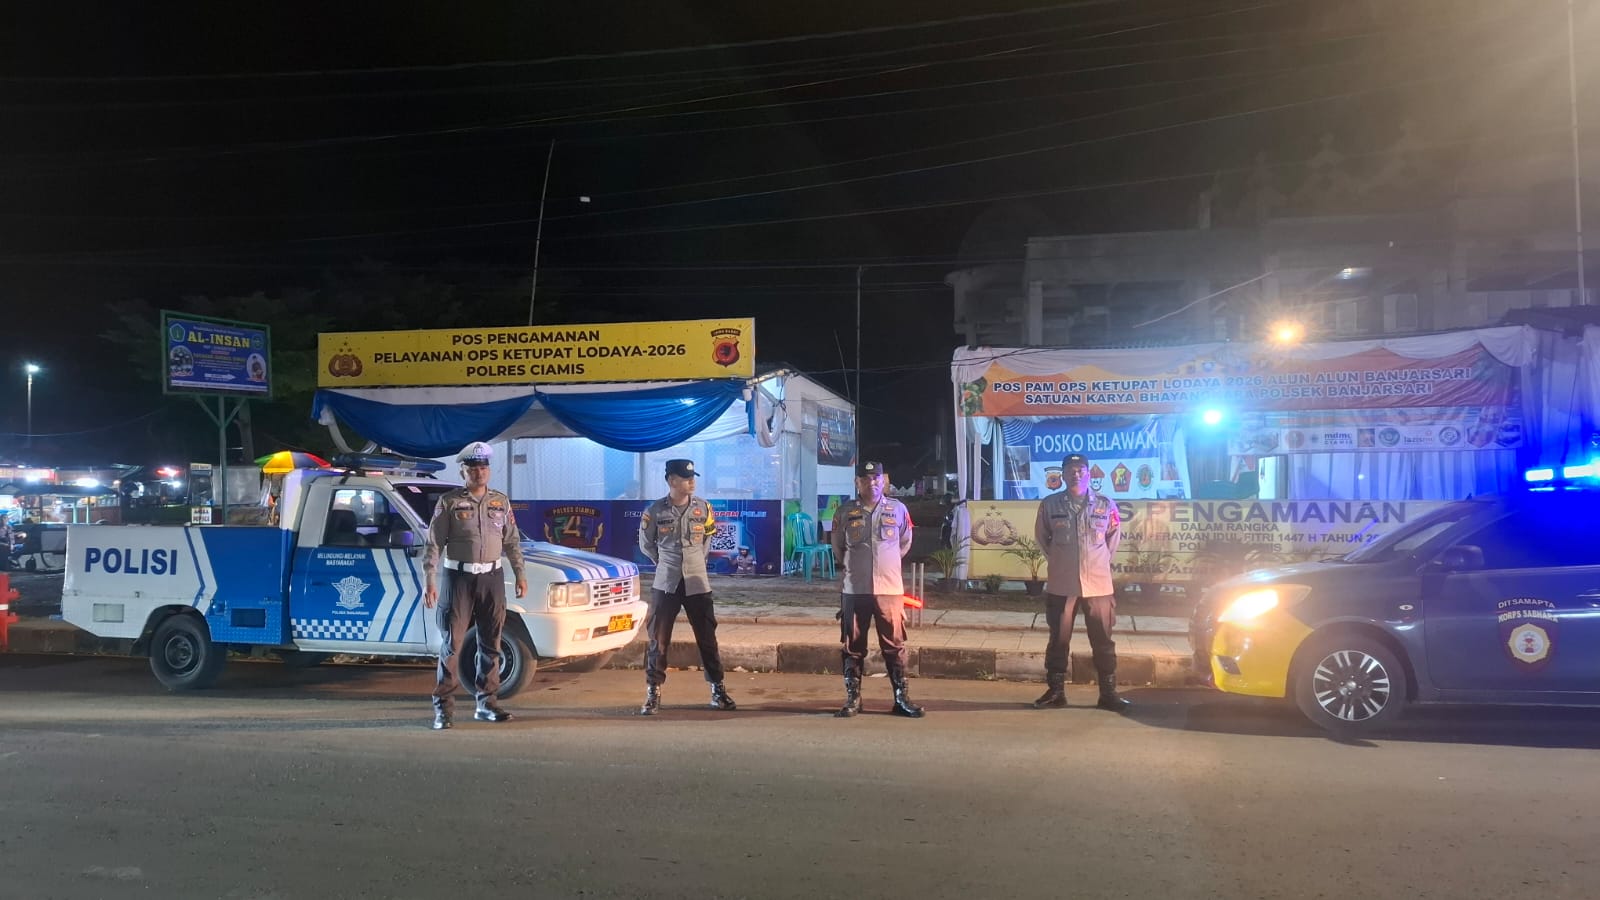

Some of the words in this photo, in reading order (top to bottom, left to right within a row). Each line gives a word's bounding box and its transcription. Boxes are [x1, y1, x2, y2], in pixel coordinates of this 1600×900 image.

[187, 331, 250, 348] AL-INSAN
[452, 334, 482, 346] POS
[487, 330, 600, 344] PENGAMANAN
[374, 351, 463, 363] PELAYANAN
[467, 349, 498, 361] OPS
[503, 347, 573, 360] KETUPAT
[578, 344, 686, 358] LODAYA-2026
[466, 365, 526, 377] POLRES
[530, 364, 585, 375] CIAMIS
[993, 382, 1021, 392] POS
[1025, 381, 1054, 392] PAM
[1058, 381, 1087, 392] OPS
[1092, 379, 1158, 391] KETUPAT
[1163, 377, 1221, 389] LODAYA
[1225, 375, 1262, 386] 2026
[1268, 374, 1310, 386] ALUN
[1315, 371, 1359, 384] ALUN
[1365, 367, 1472, 382] BANJARSARI
[1024, 394, 1081, 404] SATUAN
[1086, 393, 1137, 404] KARYA
[1261, 386, 1322, 398] POLSEK
[1327, 382, 1433, 397] BANJARSARI
[1034, 433, 1084, 453] POSKO
[1087, 431, 1157, 452] RELAWAN
[1146, 502, 1406, 522] PENGAMANAN
[1181, 523, 1223, 532] DALAM
[1226, 523, 1280, 532] RANGKA
[1246, 533, 1274, 541] FITRI
[1279, 534, 1305, 542] 1447
[1308, 534, 1317, 542] H
[1322, 534, 1363, 543] TAHUN
[84, 547, 178, 576] POLISI
